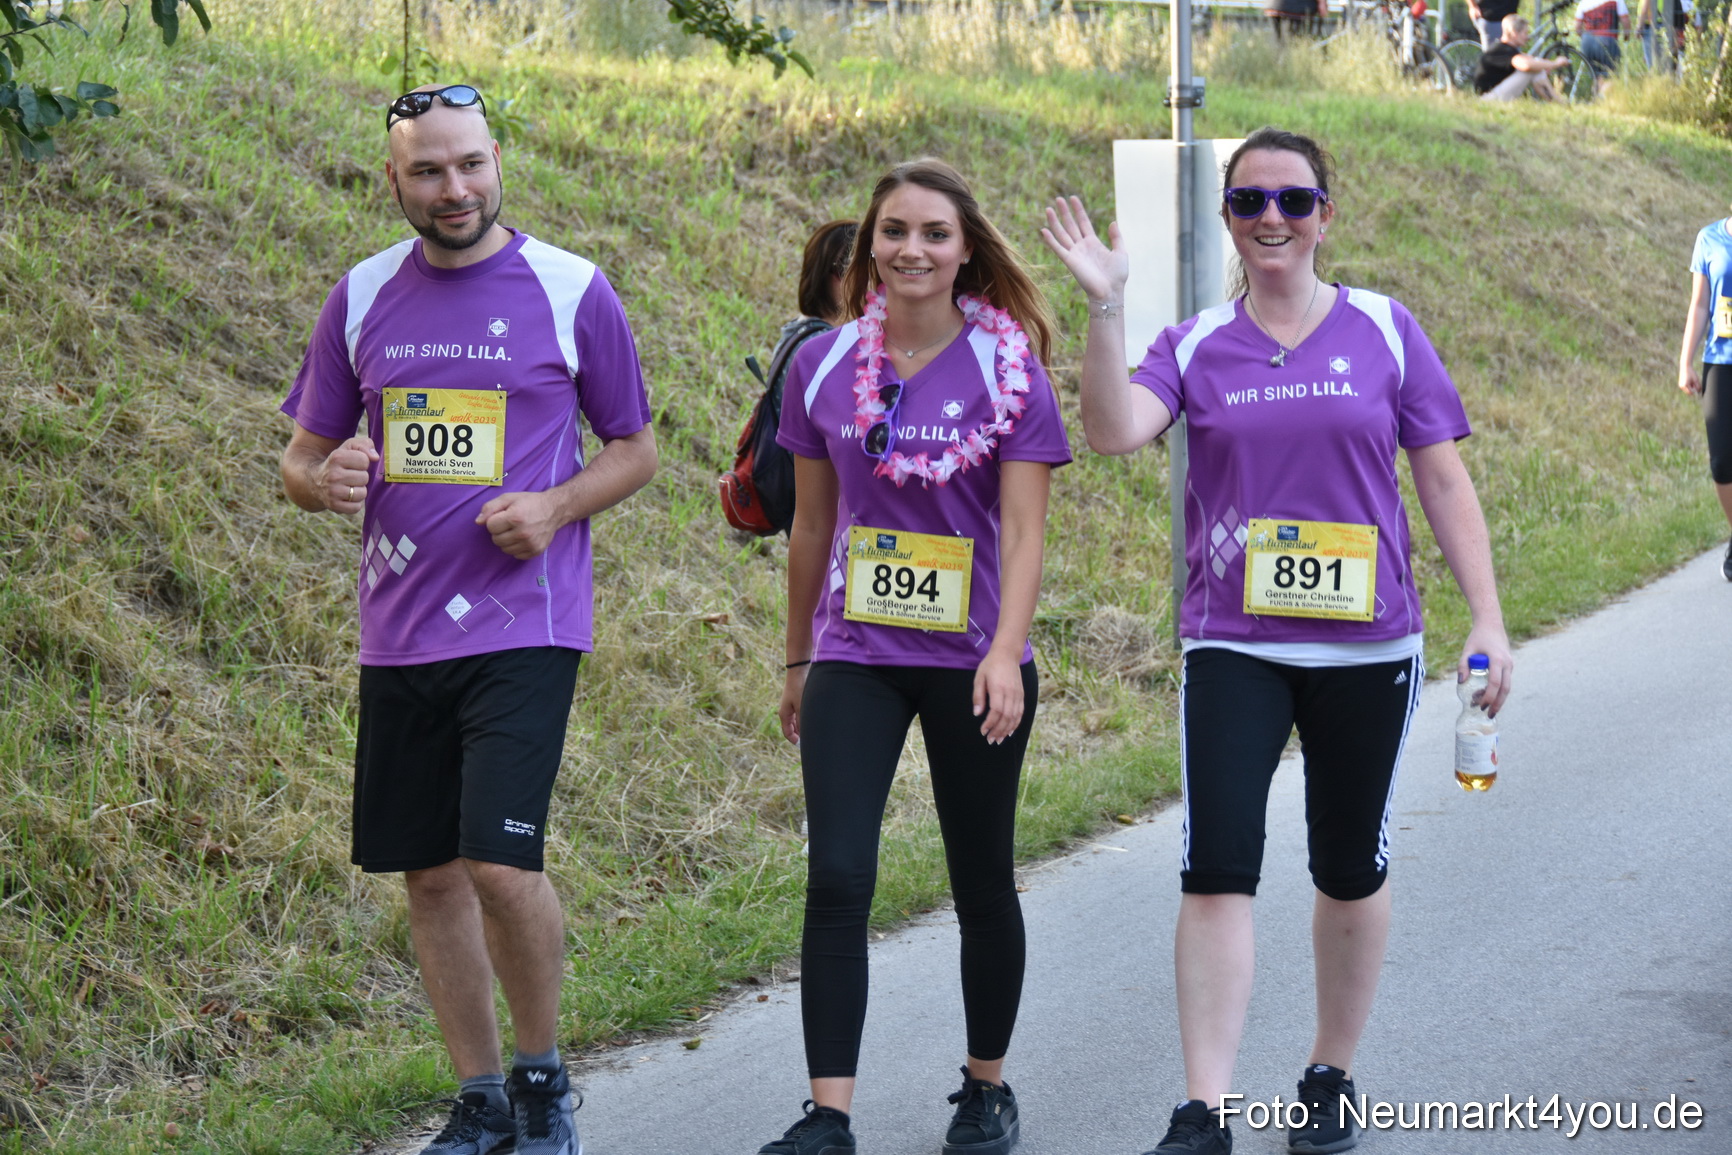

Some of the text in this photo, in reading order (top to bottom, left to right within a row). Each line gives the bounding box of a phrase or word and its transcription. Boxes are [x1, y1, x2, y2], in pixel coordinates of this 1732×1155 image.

[385, 344, 512, 360] WIR SIND LILA.
[1226, 381, 1358, 406] WIR SIND LILA.
[398, 406, 446, 416] firmenlauf
[450, 412, 496, 424] walk 2019
[841, 424, 858, 438] WI
[405, 423, 473, 458] 908
[406, 458, 473, 468] Nawrocki Sven
[1274, 556, 1342, 591] 891
[872, 564, 940, 602] 894
[1266, 589, 1354, 602] Gerstner Christine
[920, 604, 944, 614] Selin
